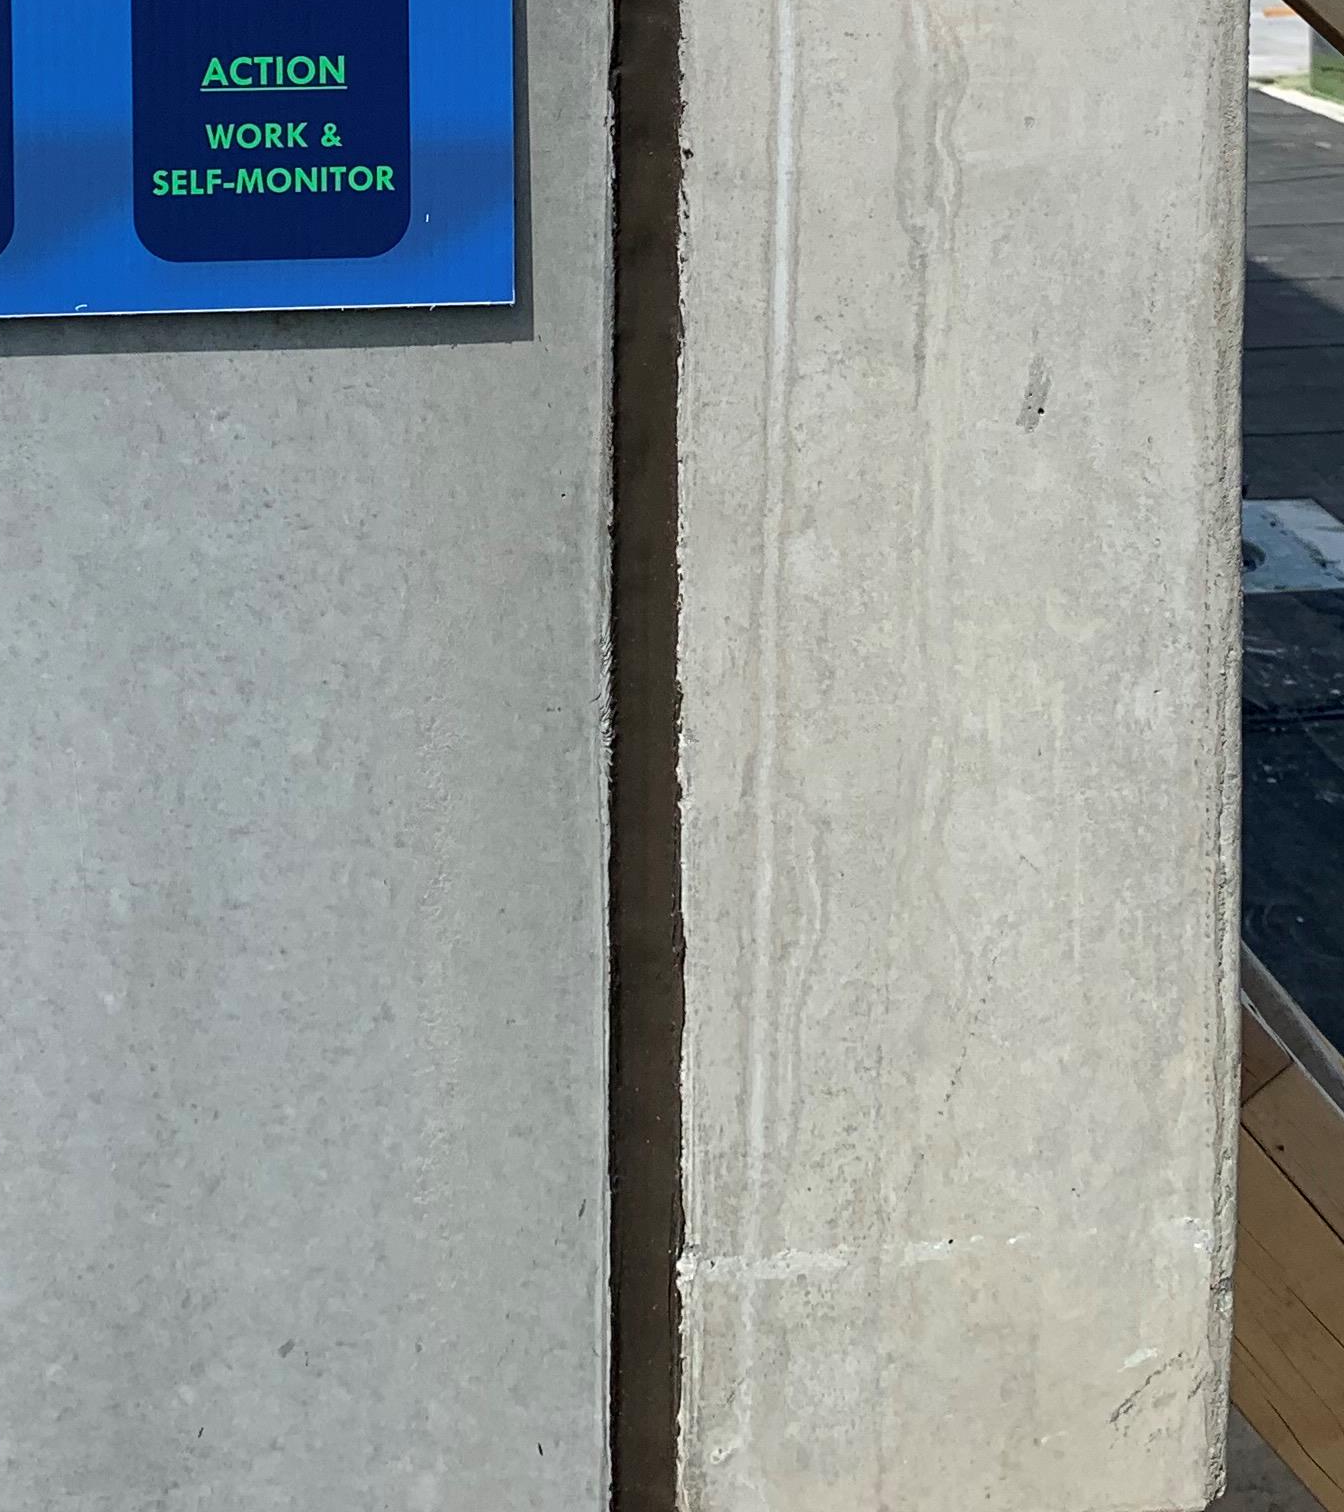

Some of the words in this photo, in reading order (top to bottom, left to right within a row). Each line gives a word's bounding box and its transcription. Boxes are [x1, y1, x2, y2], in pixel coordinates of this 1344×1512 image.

[199, 55, 348, 92] ACTION
[205, 122, 309, 150] WORK
[320, 122, 343, 148] &
[152, 165, 396, 196] SELF-MONITOR
